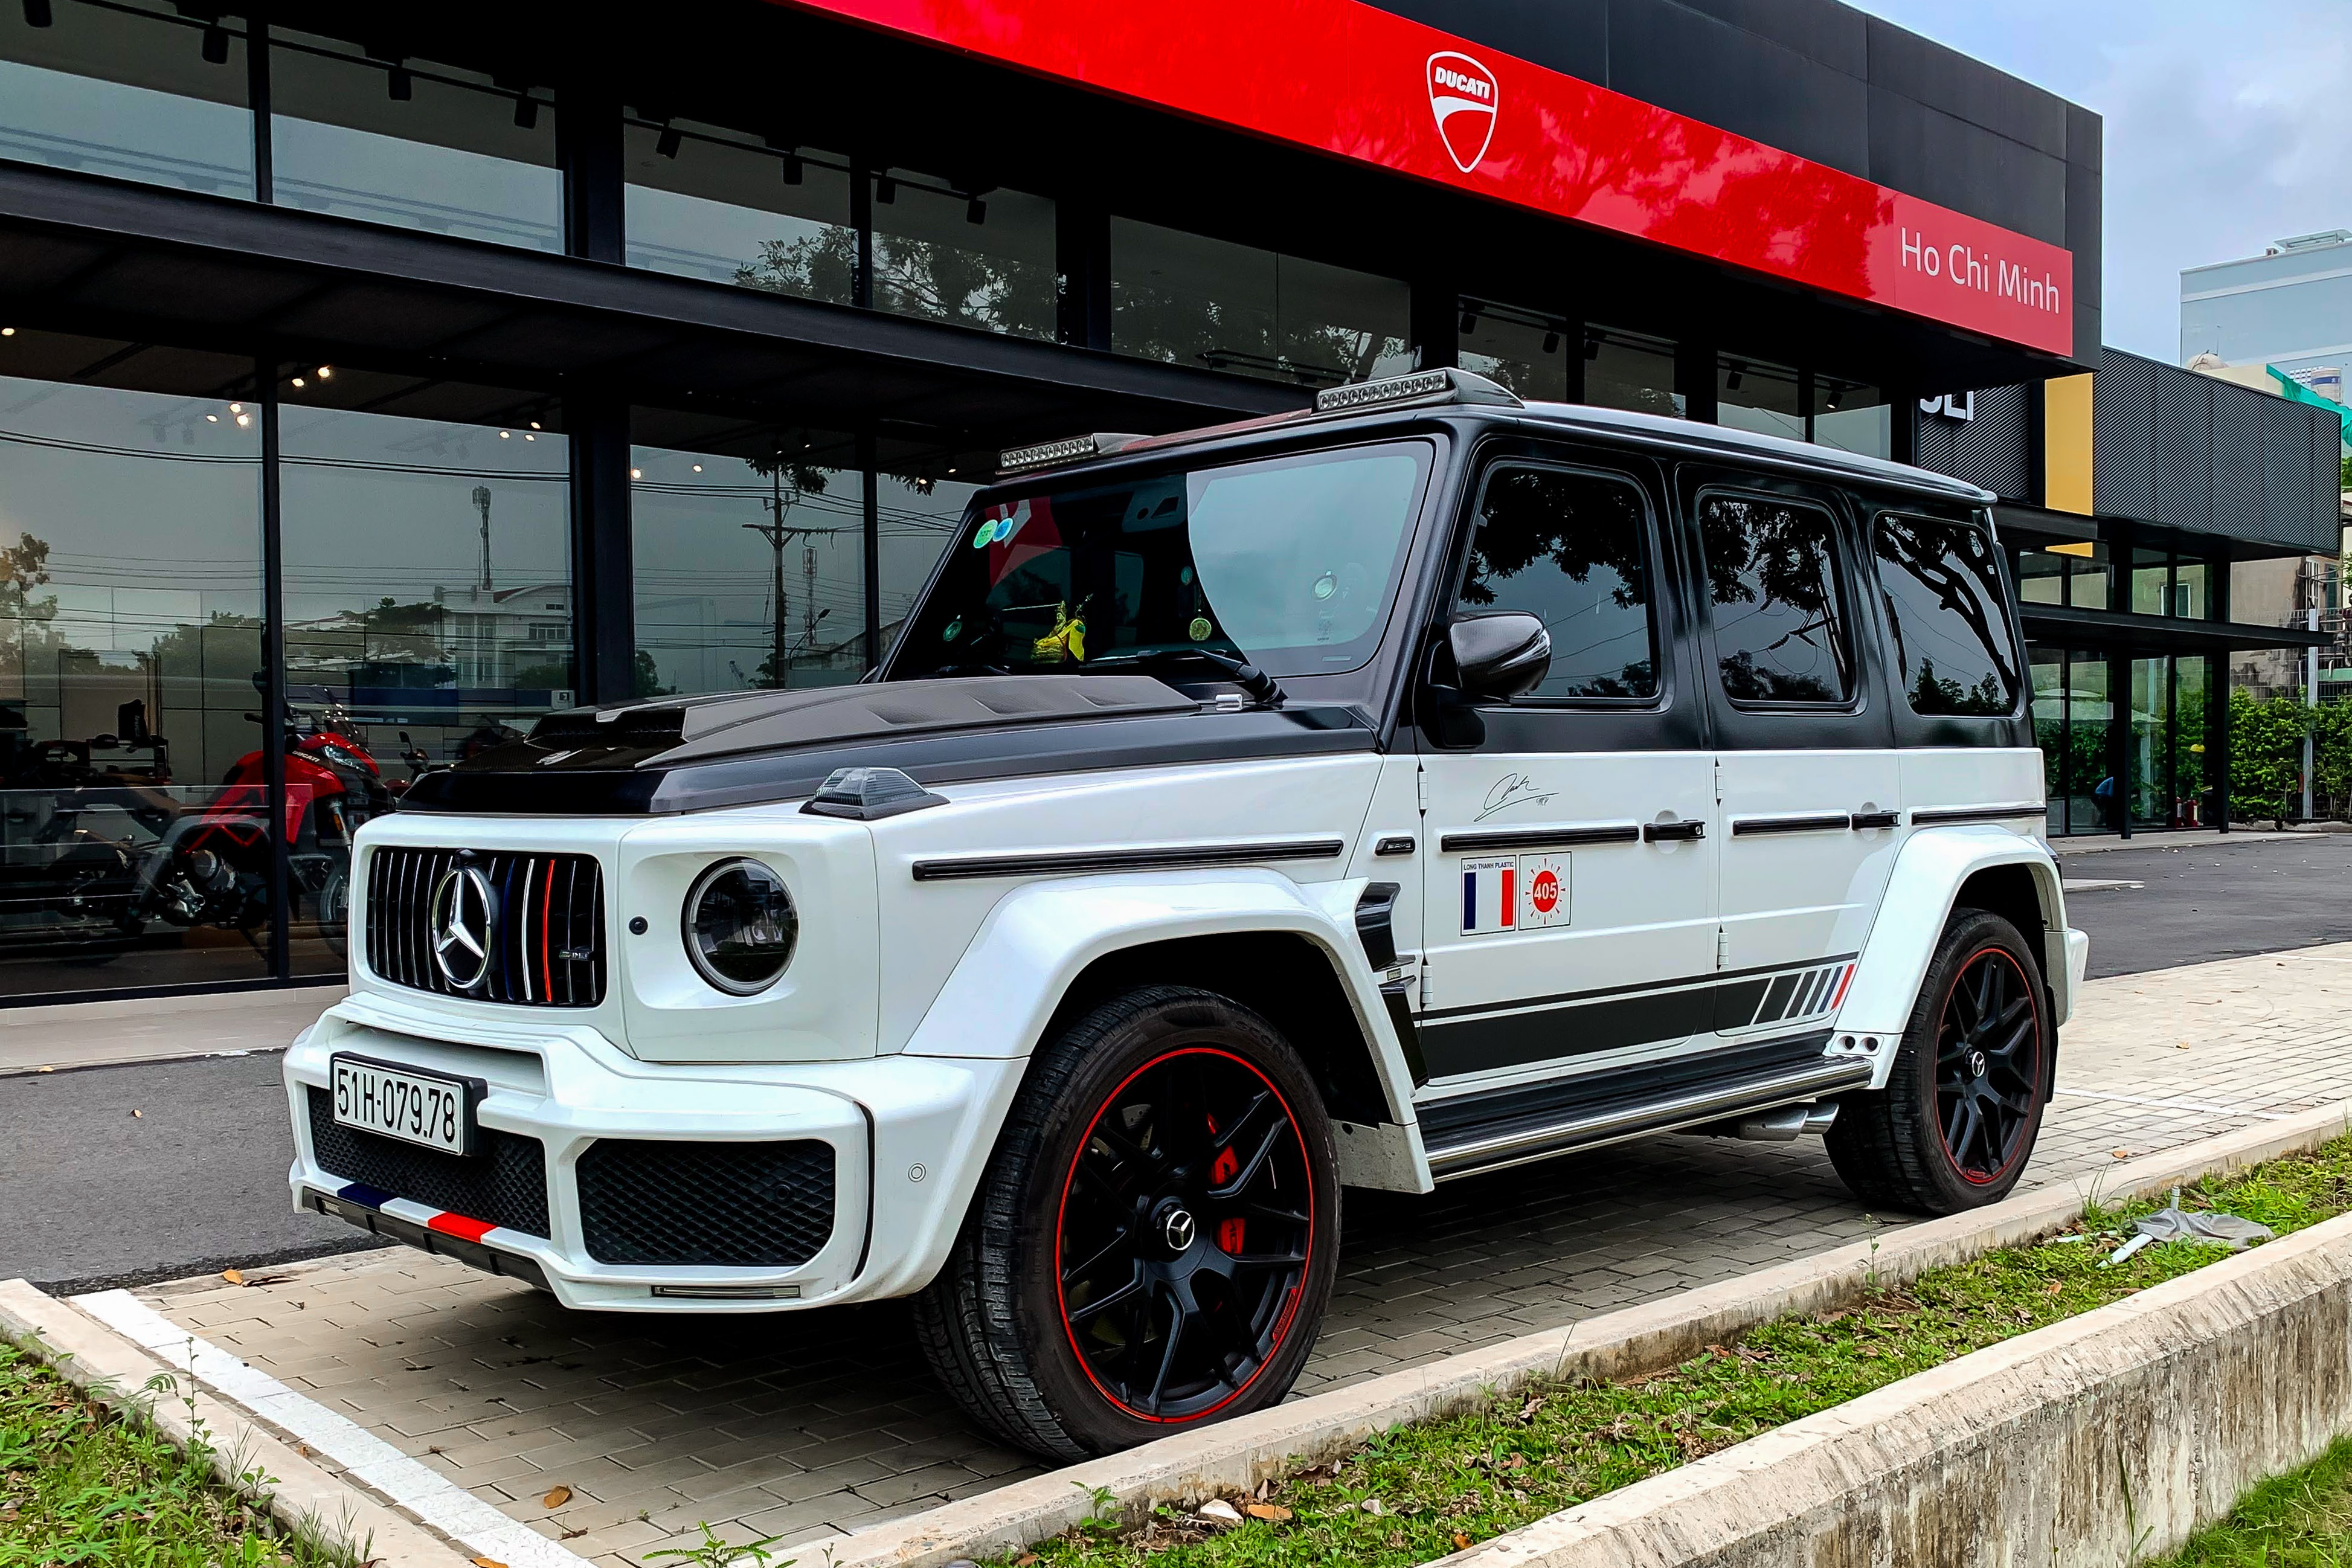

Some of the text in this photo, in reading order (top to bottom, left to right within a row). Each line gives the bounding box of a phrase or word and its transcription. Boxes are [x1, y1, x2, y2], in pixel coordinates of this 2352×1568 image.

[1435, 66, 1491, 100] DUCATI
[1901, 227, 2060, 314] Ho Chi Minh
[292, 750, 320, 762] DUCATI
[1534, 882, 1558, 900] 405
[338, 1067, 455, 1143] 51H-079.78
